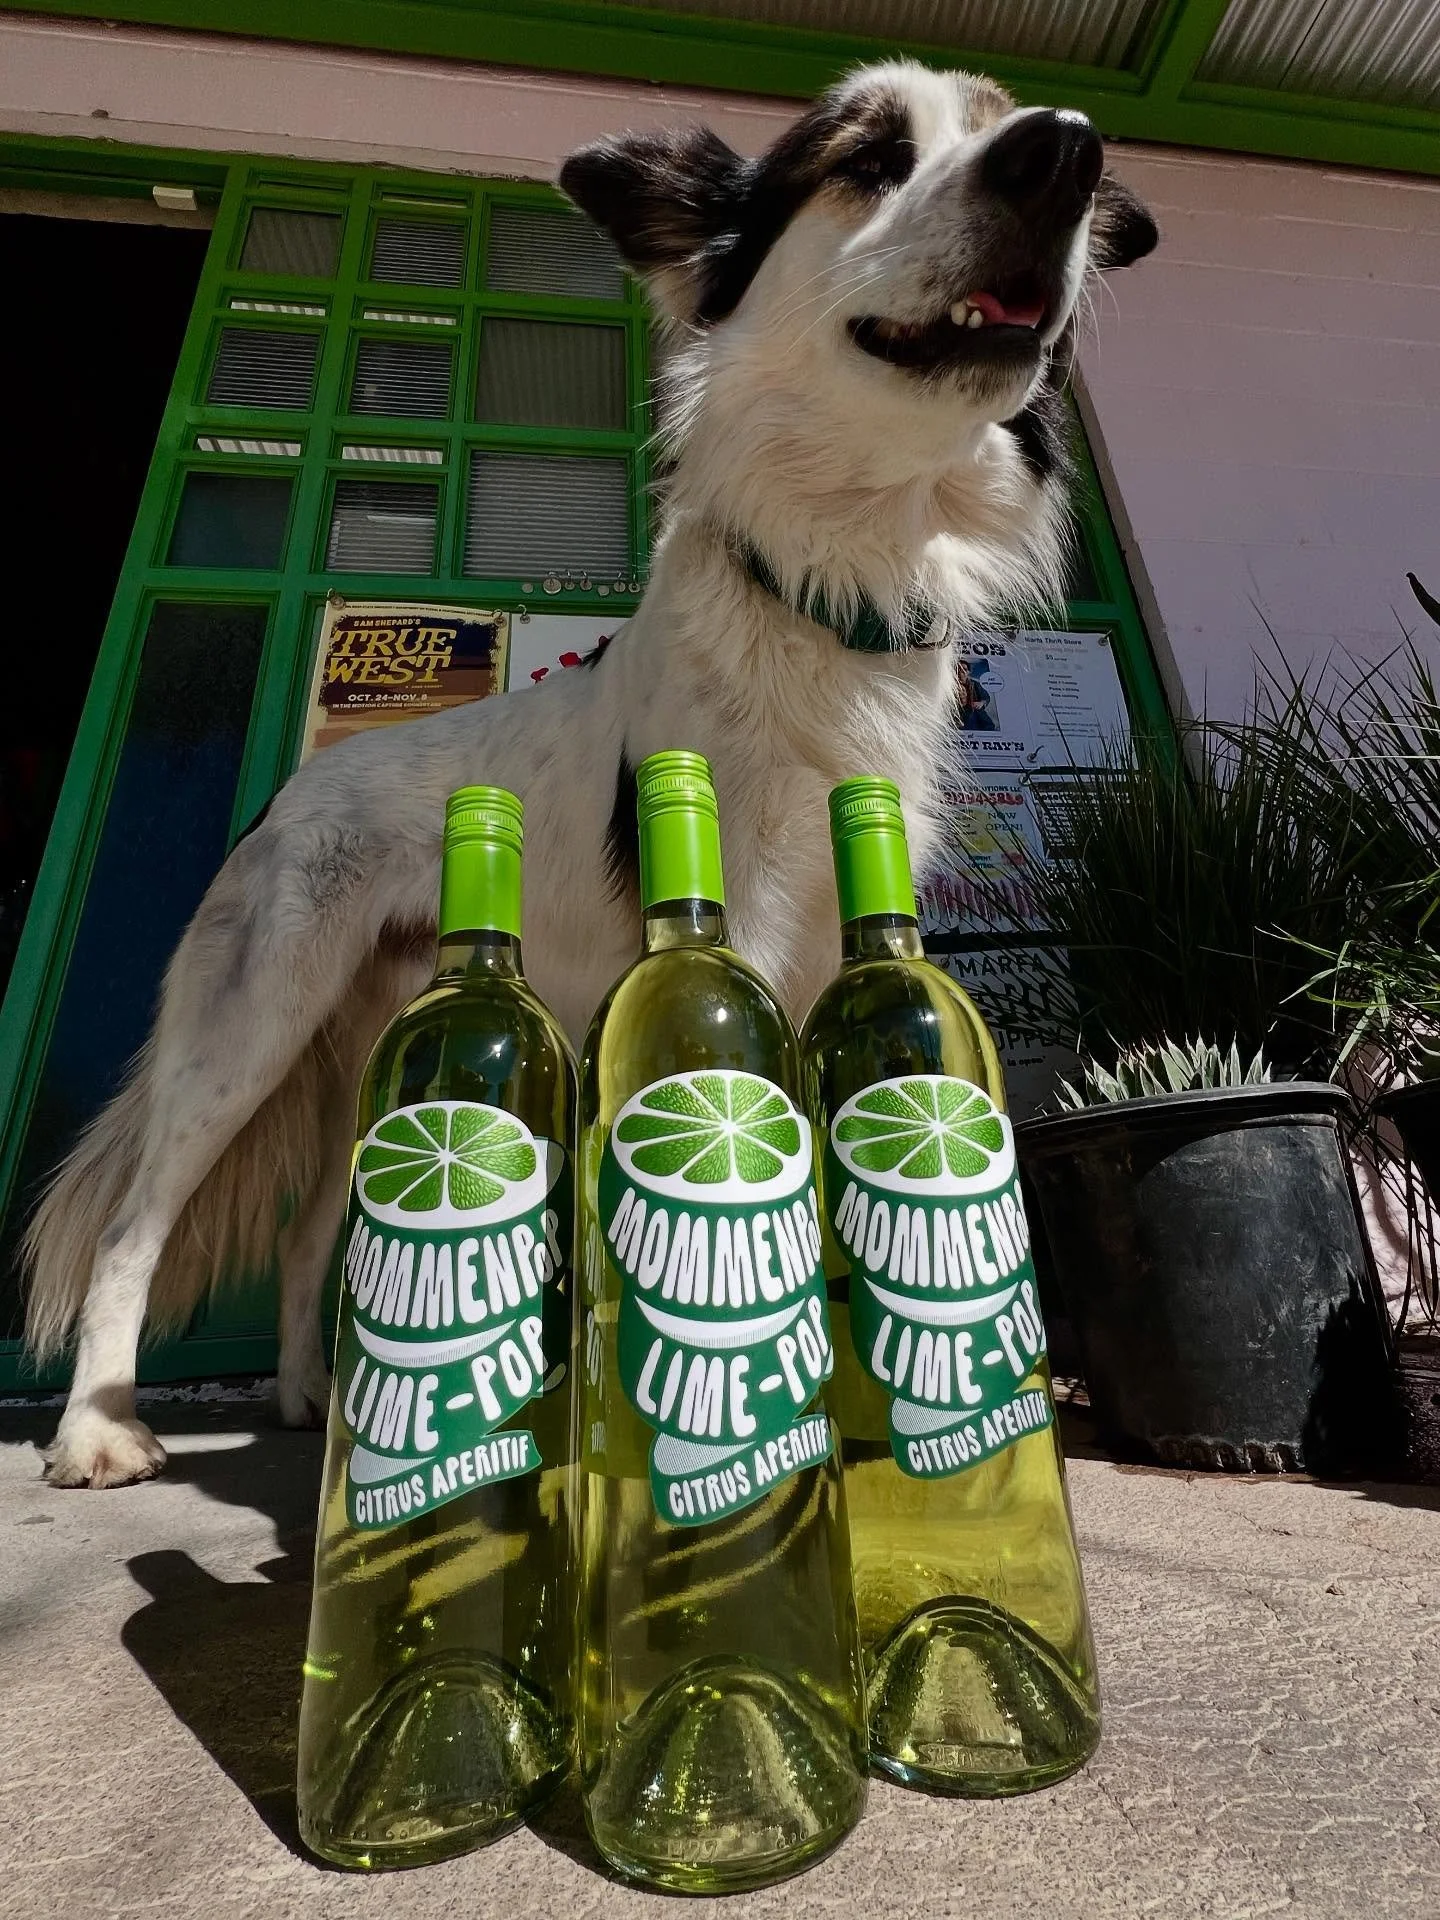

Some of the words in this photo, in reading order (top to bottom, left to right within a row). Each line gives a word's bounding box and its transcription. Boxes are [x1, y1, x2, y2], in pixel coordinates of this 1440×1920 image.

[332, 628, 457, 657] TRUE
[354, 619, 374, 627] SAM
[375, 618, 421, 627] SHEPARD'S
[327, 655, 451, 684] WEST
[955, 953, 1044, 978] MARFA
[344, 1315, 549, 1451] LIME-POP
[636, 1295, 829, 1437] LIME-POP
[871, 1280, 1042, 1404] LIME-POP
[669, 1460, 751, 1518] CITRUS
[754, 1417, 830, 1486] APERITIF
[907, 1424, 982, 1472] CITRUS
[982, 1391, 1048, 1449] APERITIF
[355, 1474, 426, 1524] CITRUS
[432, 1434, 530, 1498] APERITIF
